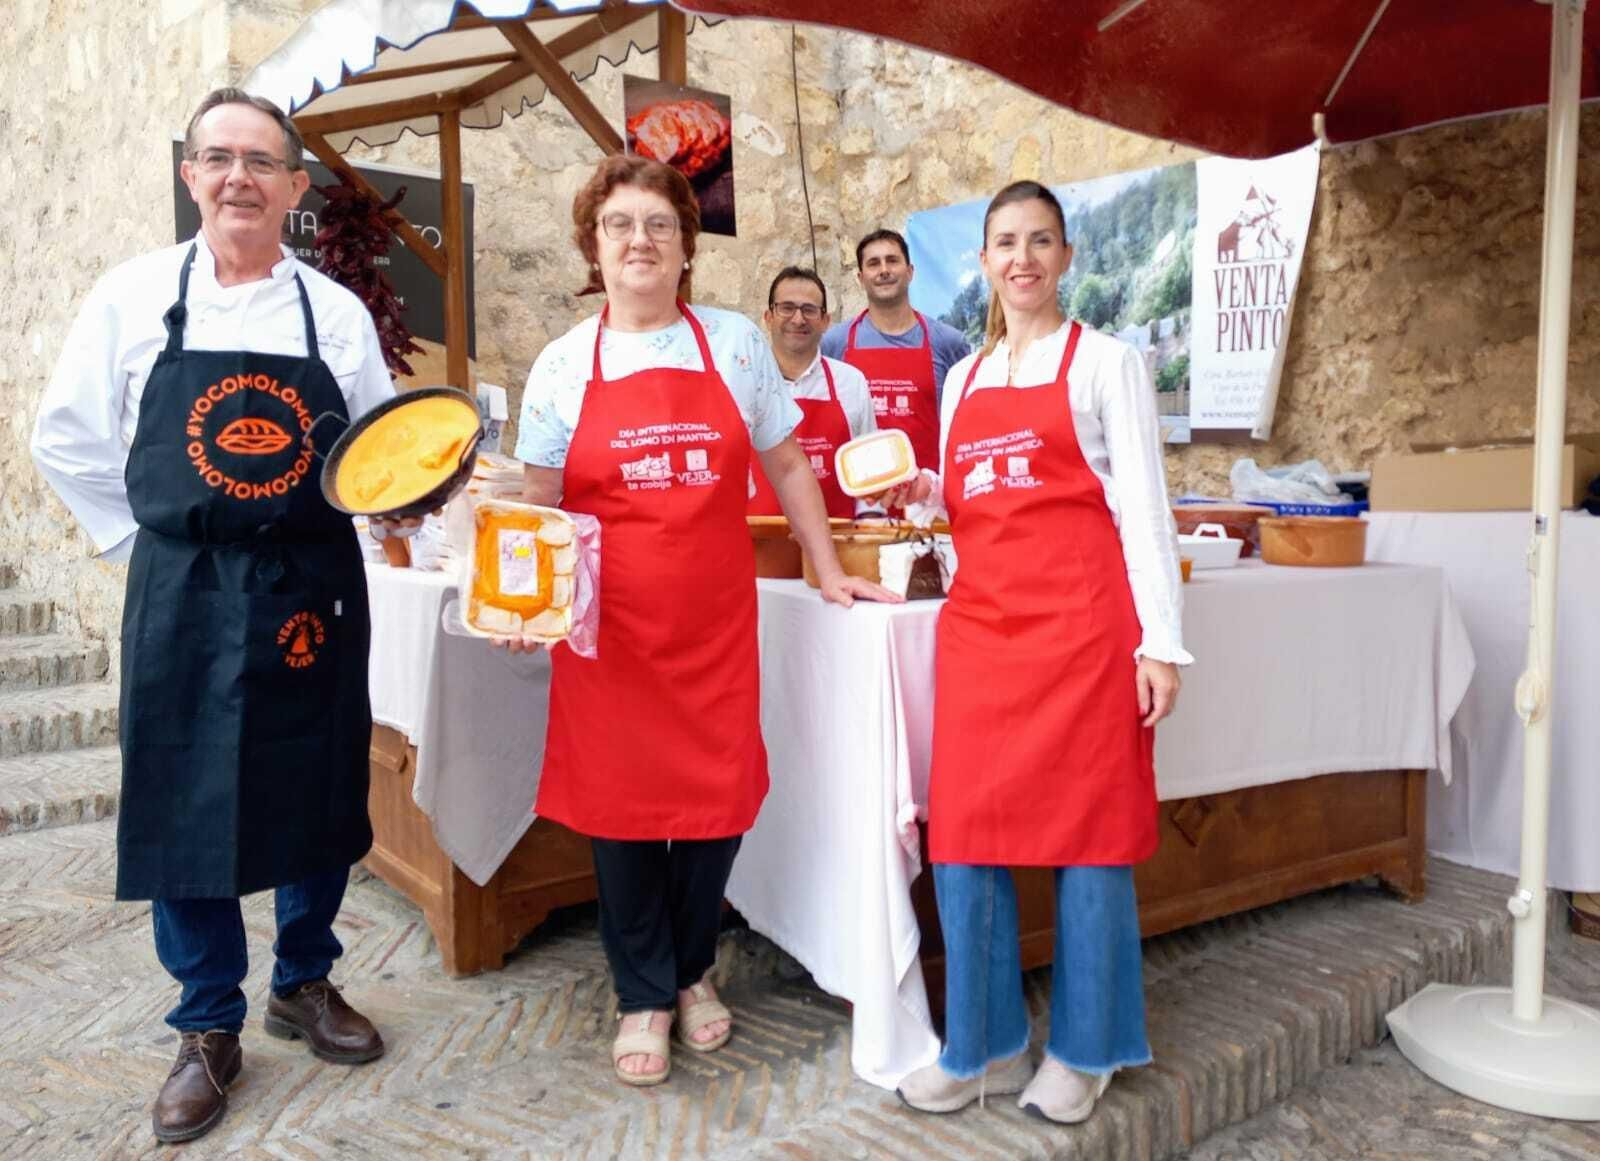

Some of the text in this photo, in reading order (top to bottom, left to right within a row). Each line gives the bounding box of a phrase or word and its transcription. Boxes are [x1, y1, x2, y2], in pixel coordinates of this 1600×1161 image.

[1214, 264, 1288, 309] VENTA
[1216, 308, 1285, 352] PINTO
[638, 423, 711, 436] INTERNACIONAL
[610, 439, 629, 448] DEL
[631, 436, 660, 447] LOMO
[677, 432, 720, 443] MANTECA
[676, 470, 713, 482] VEJER
[999, 476, 1035, 487] VEJER
